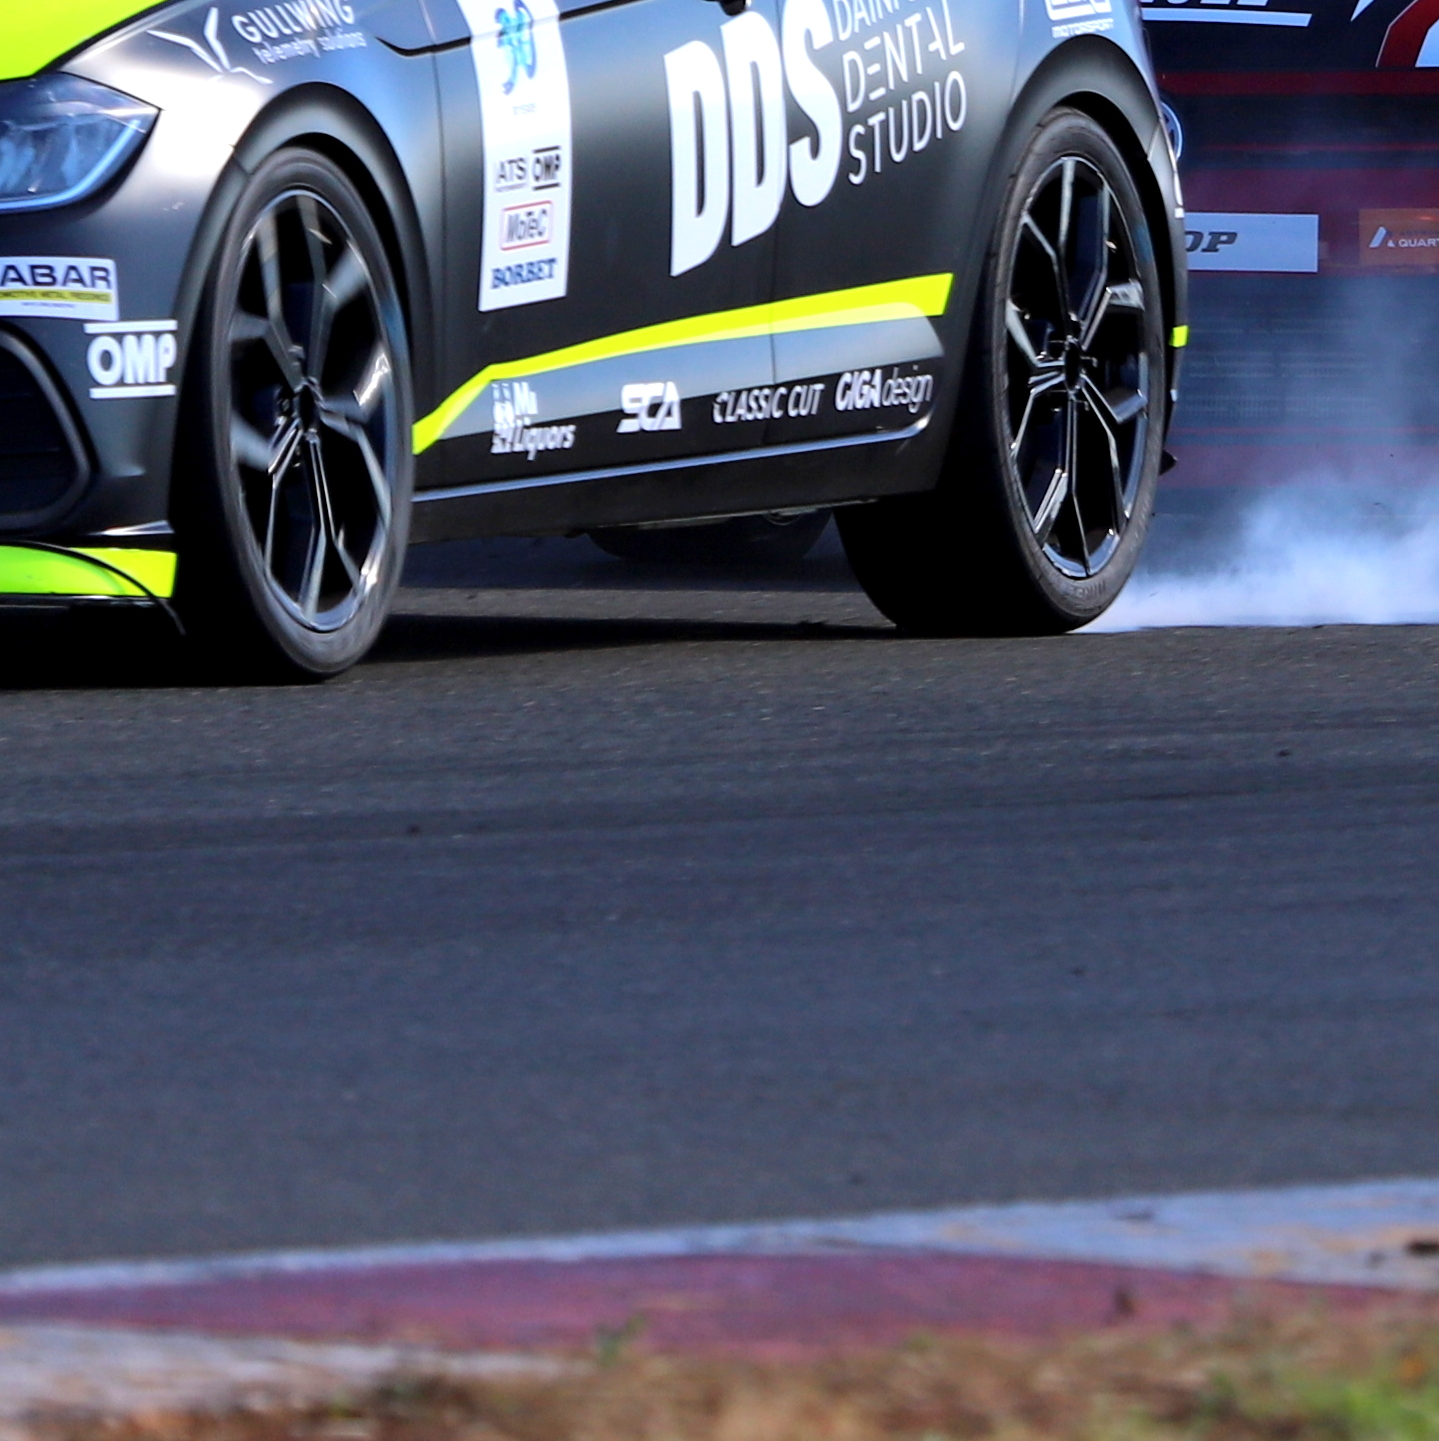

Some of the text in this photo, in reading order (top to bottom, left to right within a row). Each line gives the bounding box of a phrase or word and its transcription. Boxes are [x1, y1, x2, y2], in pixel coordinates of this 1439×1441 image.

[847, 71, 967, 186] STUDIO
[87, 333, 177, 386] OMP
[713, 383, 825, 424] CLASSIC CUT
